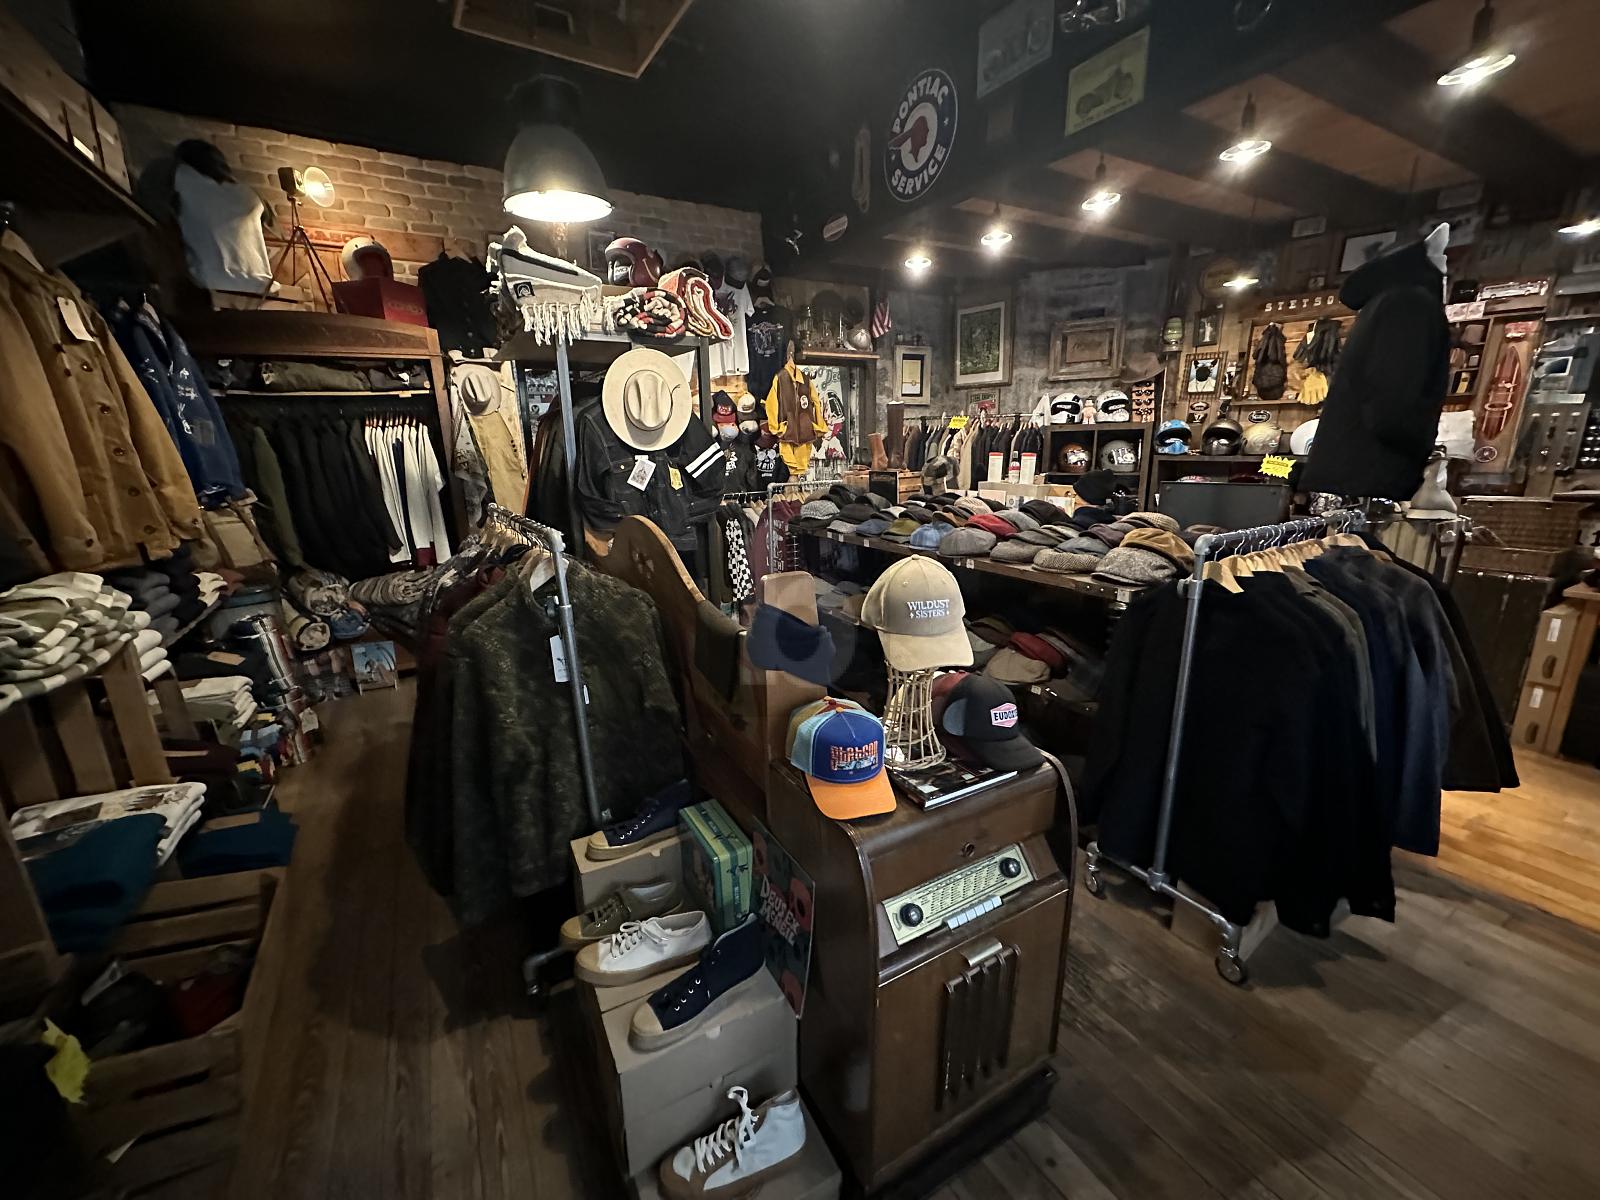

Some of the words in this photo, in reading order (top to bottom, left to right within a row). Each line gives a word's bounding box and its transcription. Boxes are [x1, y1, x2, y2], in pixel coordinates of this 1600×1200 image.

[892, 76, 949, 133] PONTIAC
[891, 144, 946, 194] SERVICE
[1264, 295, 1341, 312] STETSO
[907, 599, 950, 610] WILDUST
[915, 609, 945, 618] SISTERS
[760, 874, 787, 916] DEUS
[785, 909, 800, 936] EX
